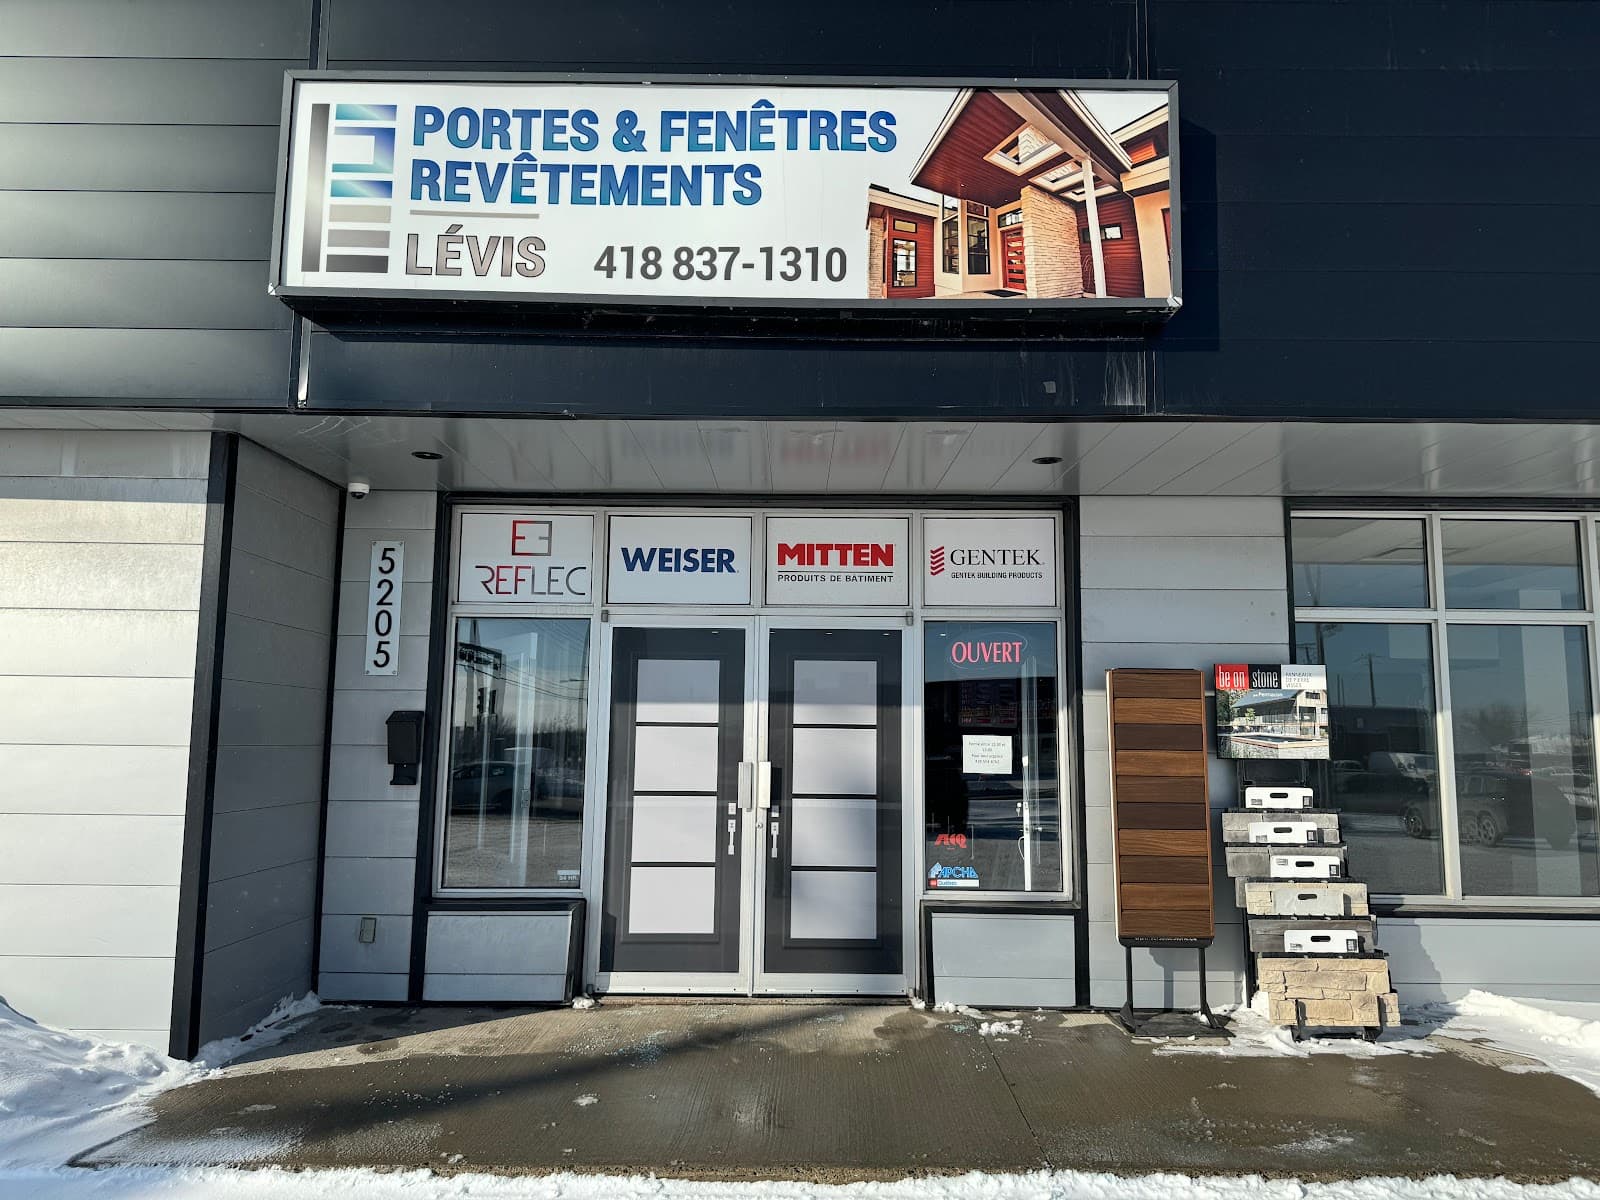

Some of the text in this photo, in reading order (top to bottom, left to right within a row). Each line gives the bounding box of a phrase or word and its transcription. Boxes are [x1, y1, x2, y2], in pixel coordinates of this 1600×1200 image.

[413, 98, 898, 153] PORTES & FENÊTRES
[410, 153, 763, 206] REVÊTEMENTS
[405, 224, 547, 278] LÉVIS
[593, 246, 848, 282] 418 837-1310
[620, 547, 737, 573] WEISER
[777, 543, 894, 567] MITTEN
[950, 549, 1042, 565] GENTEK
[475, 565, 587, 596] REFLEC
[777, 574, 826, 583] PRODUITS
[829, 574, 842, 583] DE
[951, 571, 1043, 579] GENTEK BUILDING PRODUCTS
[373, 547, 396, 668] 5205
[951, 641, 1023, 663] OUVERT
[1252, 669, 1279, 688] stone
